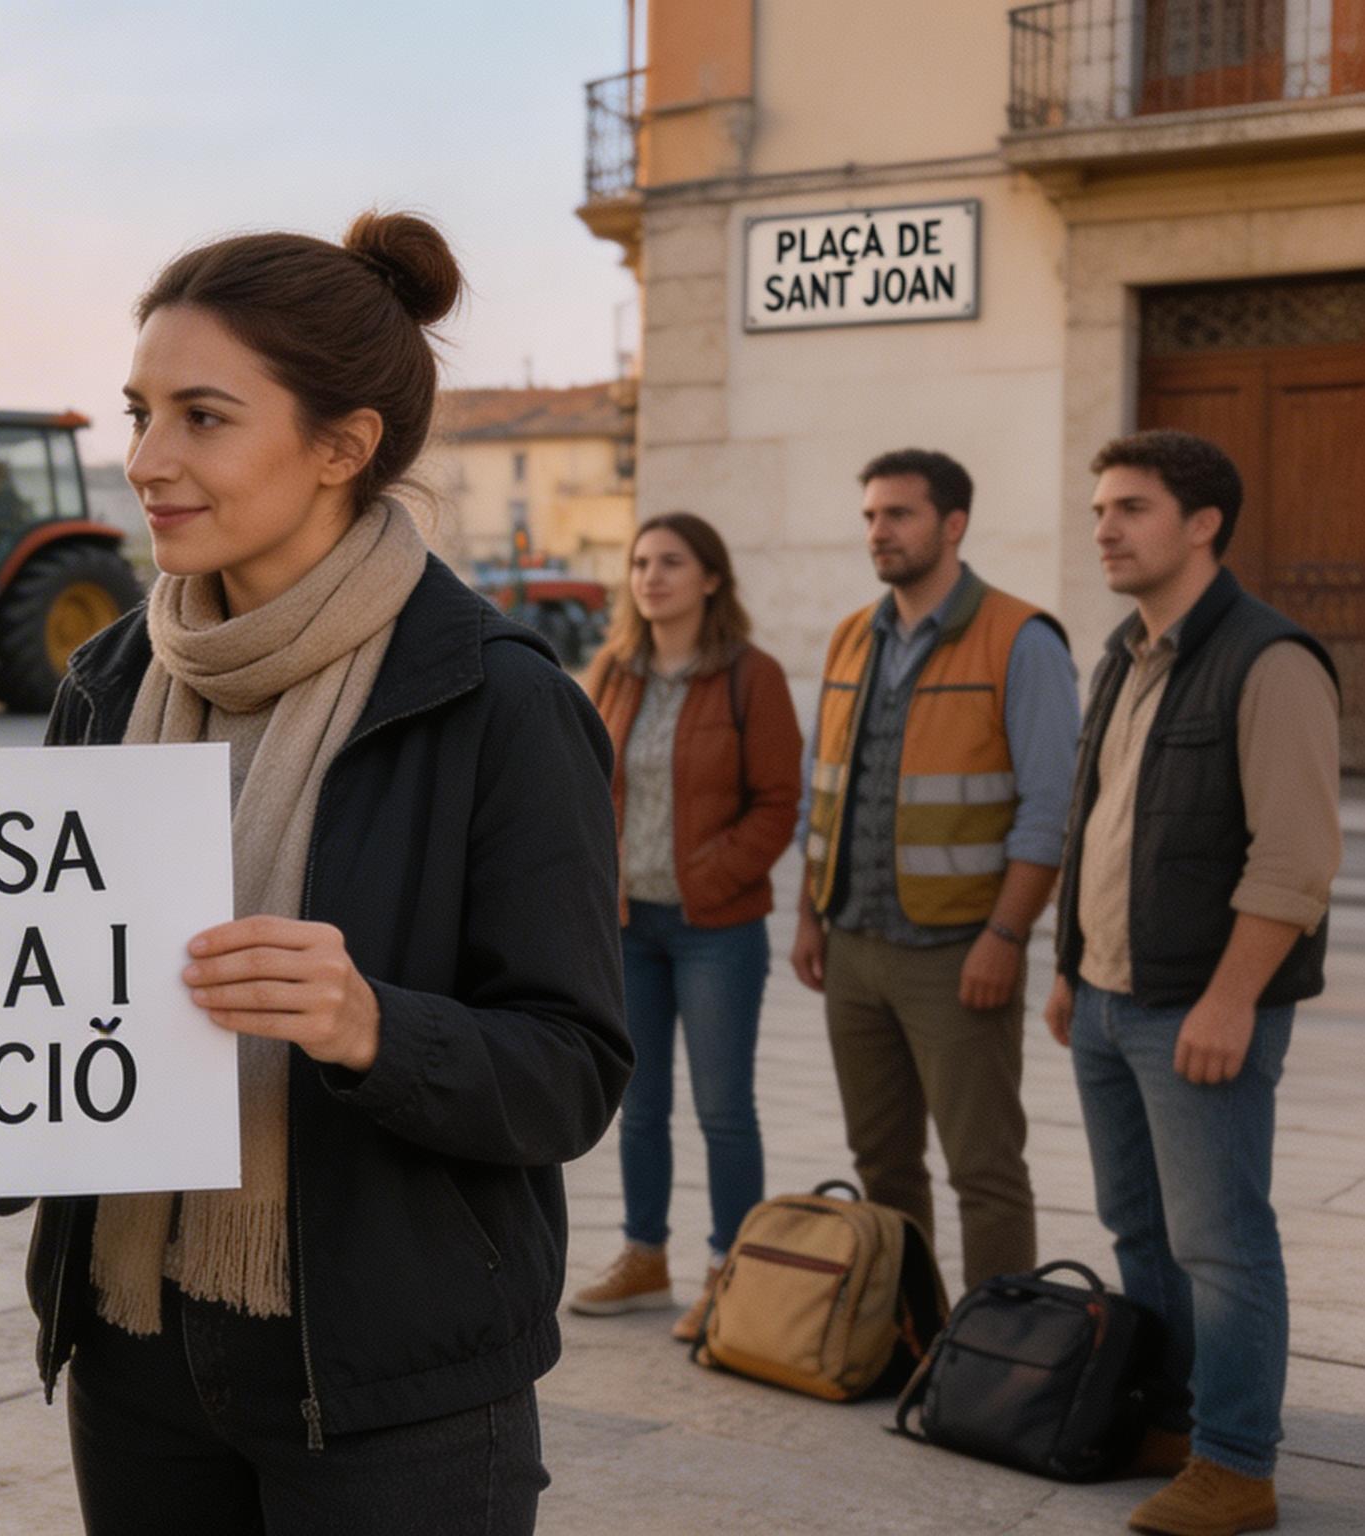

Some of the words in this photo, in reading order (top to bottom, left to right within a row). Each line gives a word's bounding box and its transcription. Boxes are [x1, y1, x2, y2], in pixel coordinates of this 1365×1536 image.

[898, 219, 942, 257] DE
[764, 270, 854, 312] SANT
[862, 263, 956, 307] JOAN
[109, 922, 131, 1006] I
